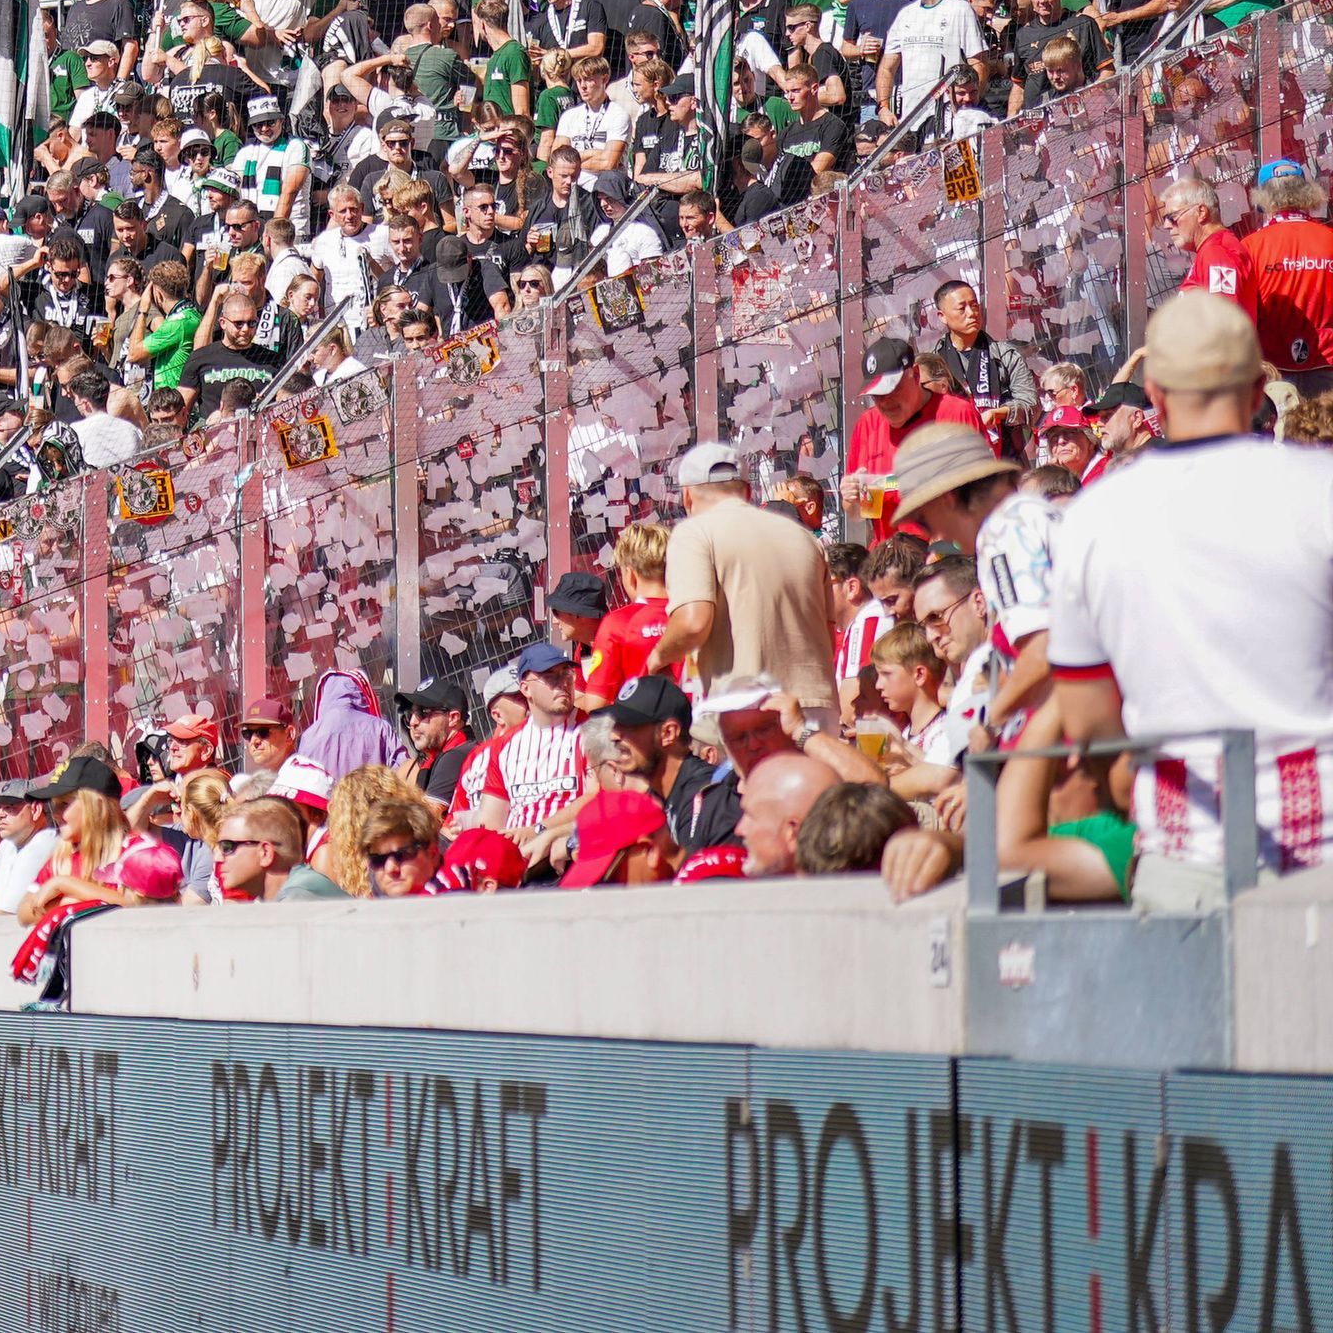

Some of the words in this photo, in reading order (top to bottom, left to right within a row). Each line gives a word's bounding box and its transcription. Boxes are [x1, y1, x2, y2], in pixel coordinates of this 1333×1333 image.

[511, 777, 577, 798] Lexware
[37, 1045, 120, 1208] KRAFT
[210, 1058, 376, 1258] PROJEKT
[402, 1070, 548, 1290] KRAFT
